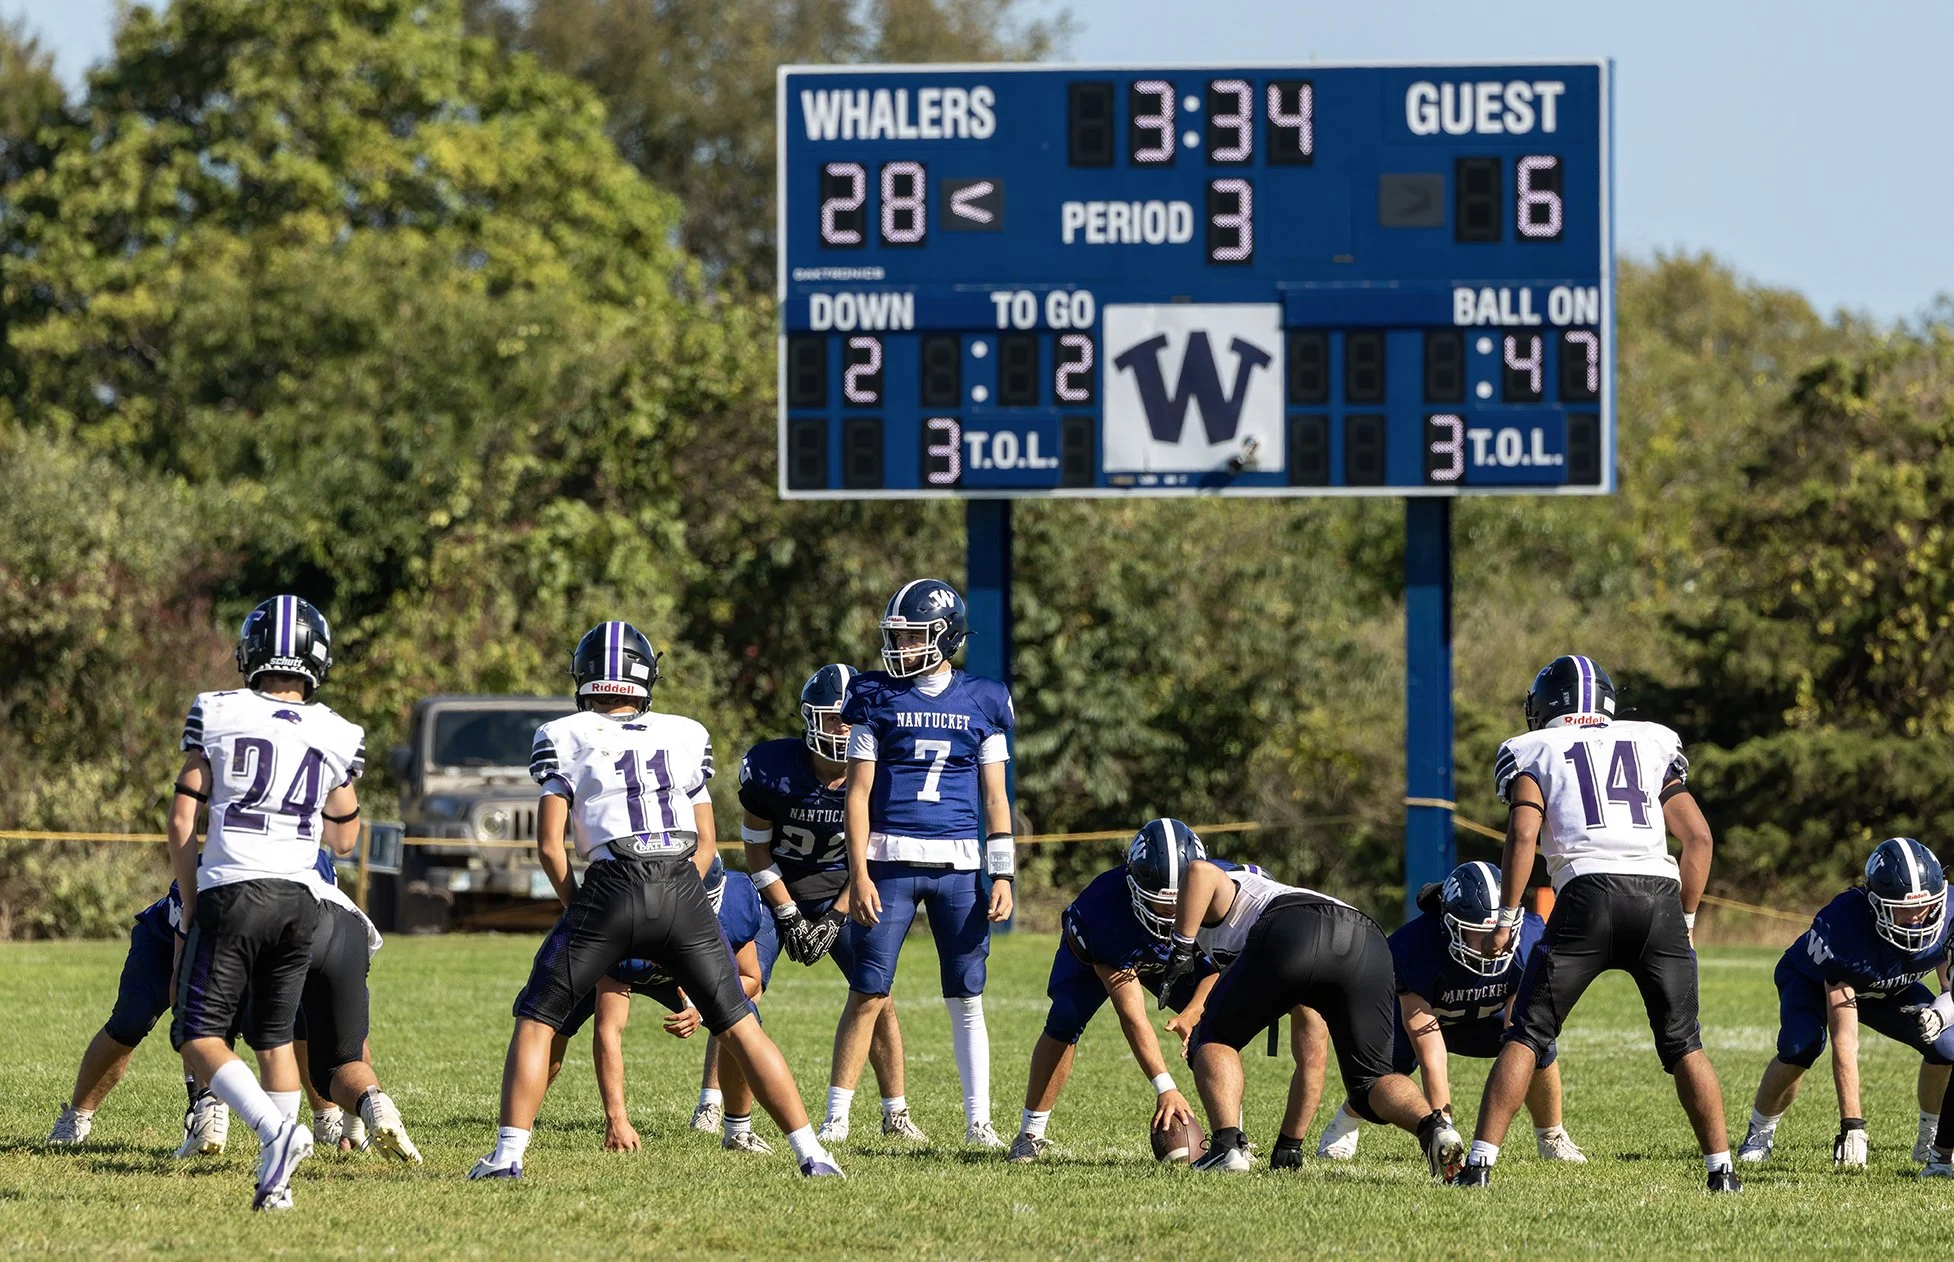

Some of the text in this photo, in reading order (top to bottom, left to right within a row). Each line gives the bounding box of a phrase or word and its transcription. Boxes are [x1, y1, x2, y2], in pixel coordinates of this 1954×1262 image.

[800, 86, 997, 142] WHALERS
[1133, 79, 1314, 163] 3:34
[1405, 80, 1566, 136] GUEST
[820, 161, 927, 245] 28
[1061, 200, 1194, 245] PERIOD
[1211, 178, 1253, 261] 3
[1516, 155, 1563, 238] 6
[809, 291, 915, 331] DOWN
[990, 289, 1096, 330] TO GO
[1453, 286, 1599, 326] BALL ON
[843, 336, 883, 403] 2
[1114, 330, 1273, 447] W
[927, 417, 962, 484] 3
[964, 430, 1059, 469] T.O.L.
[1430, 414, 1465, 481] 3
[1467, 427, 1564, 467] T.O.L.
[928, 589, 956, 608] W
[270, 656, 303, 667] schutt
[591, 682, 635, 694] Riddell
[896, 711, 971, 731] NANTUCKET
[1563, 715, 1606, 726] Riddell
[222, 736, 328, 841] 24
[614, 749, 682, 832] 11
[914, 739, 952, 803] 7
[1563, 739, 1653, 830] 14
[1807, 928, 1834, 965] W
